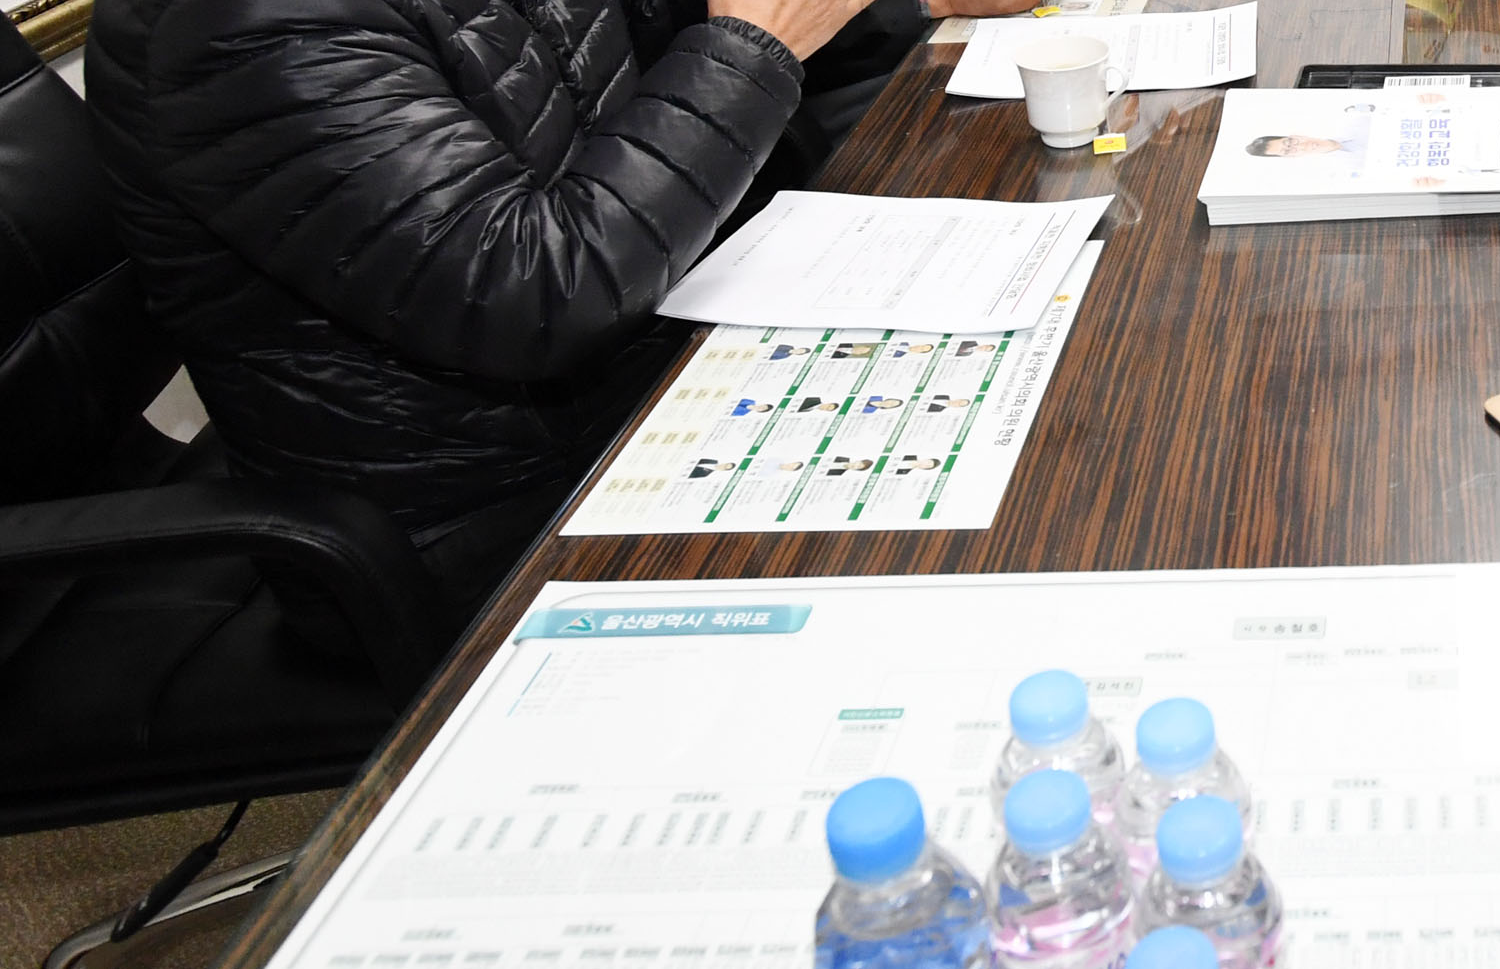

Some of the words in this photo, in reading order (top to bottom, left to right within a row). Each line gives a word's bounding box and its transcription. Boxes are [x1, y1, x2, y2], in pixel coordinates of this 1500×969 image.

[1036, 326, 1057, 348] 후반기
[1011, 350, 1048, 407] 울산광역시의회
[1002, 408, 1023, 426] 의원
[993, 428, 1015, 446] 현황
[601, 611, 704, 631] 울산광역시
[711, 609, 773, 628] 직위표
